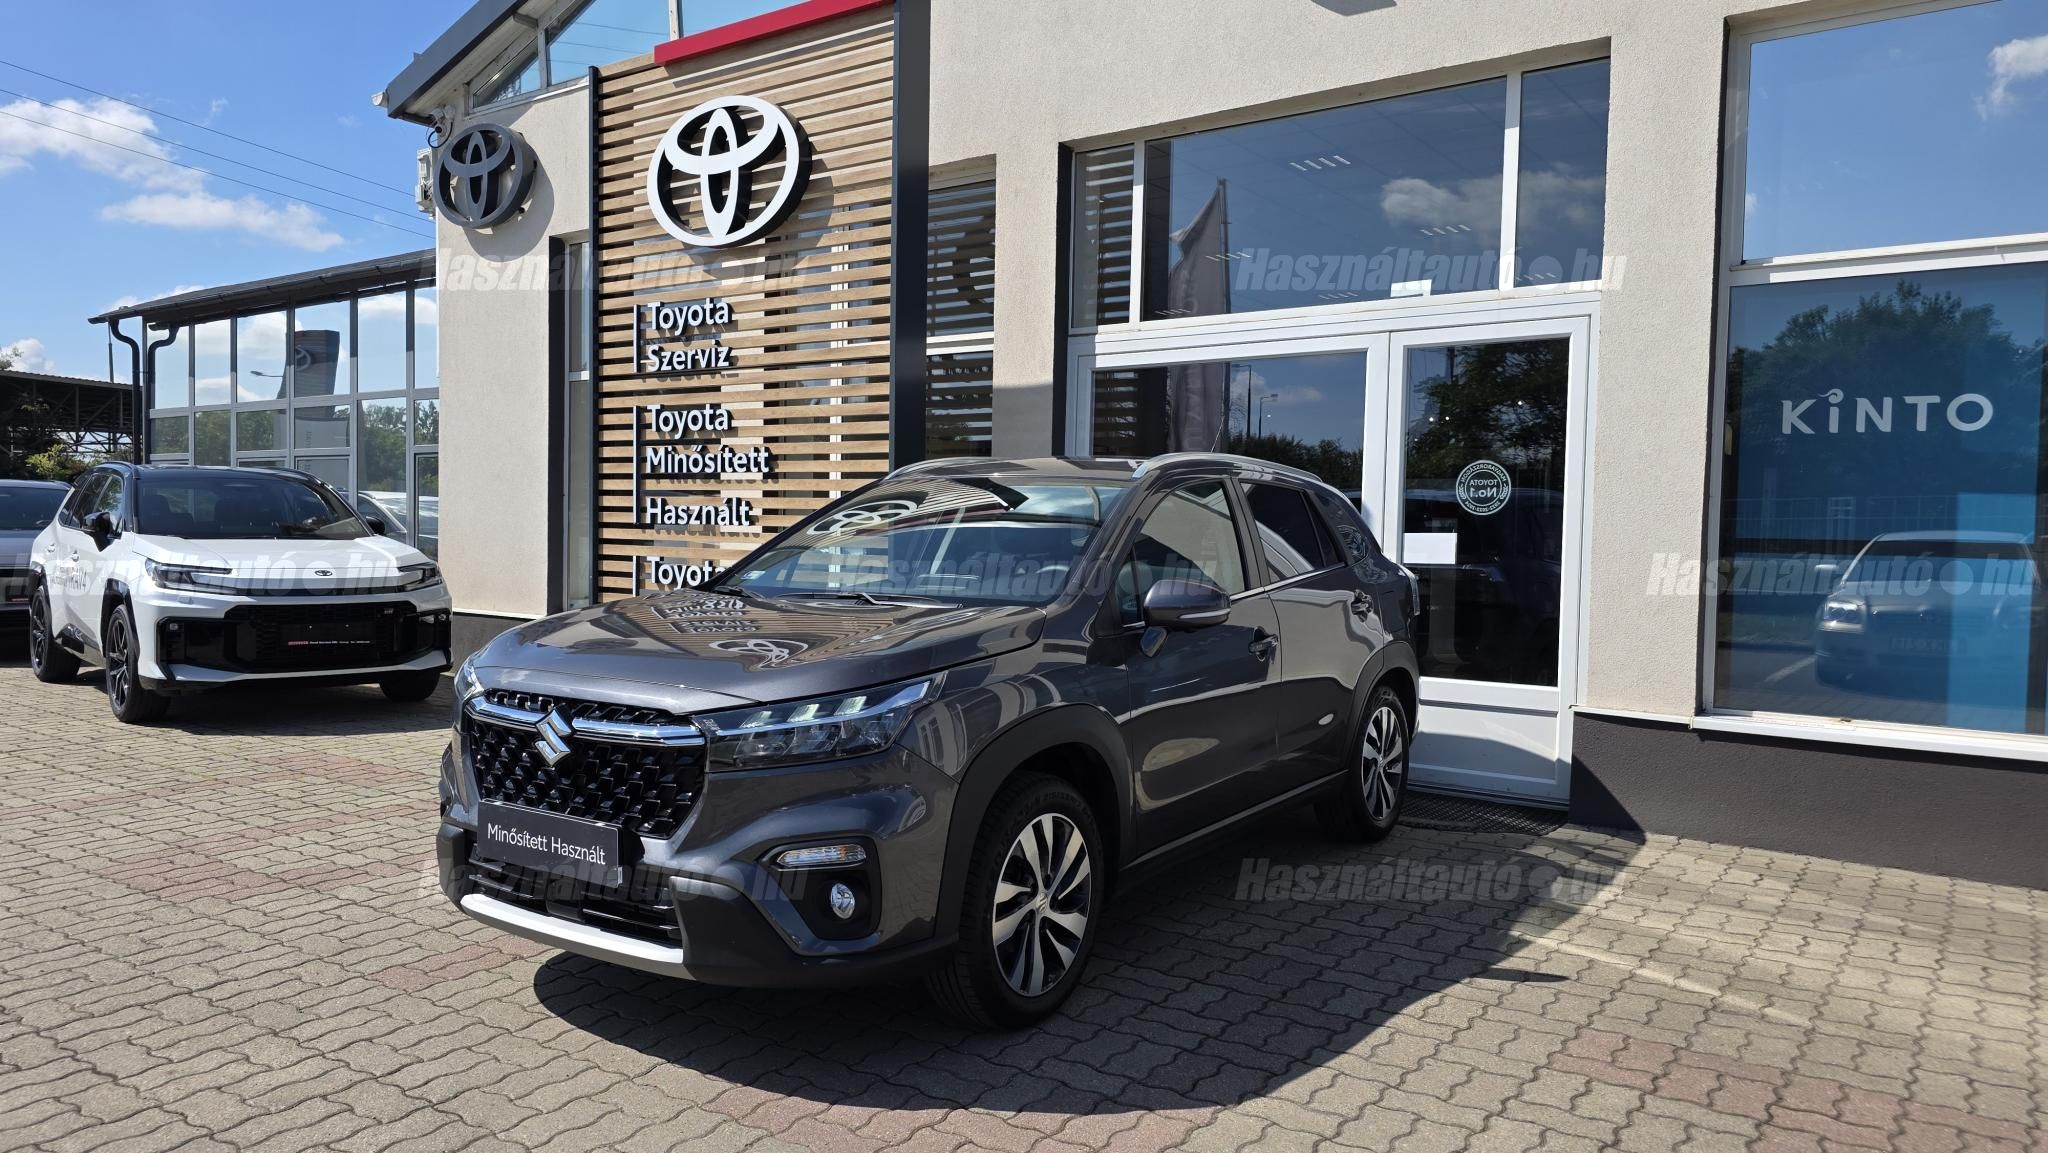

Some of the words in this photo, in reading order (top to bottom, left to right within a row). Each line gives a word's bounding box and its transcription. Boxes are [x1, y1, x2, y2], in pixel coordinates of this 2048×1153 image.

[647, 298, 730, 335] Toyota
[647, 339, 731, 373] Szerviz
[647, 403, 730, 439] Toyota
[646, 446, 770, 474] Minősített
[646, 497, 751, 526] Használt
[487, 822, 548, 852] Minősített
[551, 836, 606, 865] Használt
